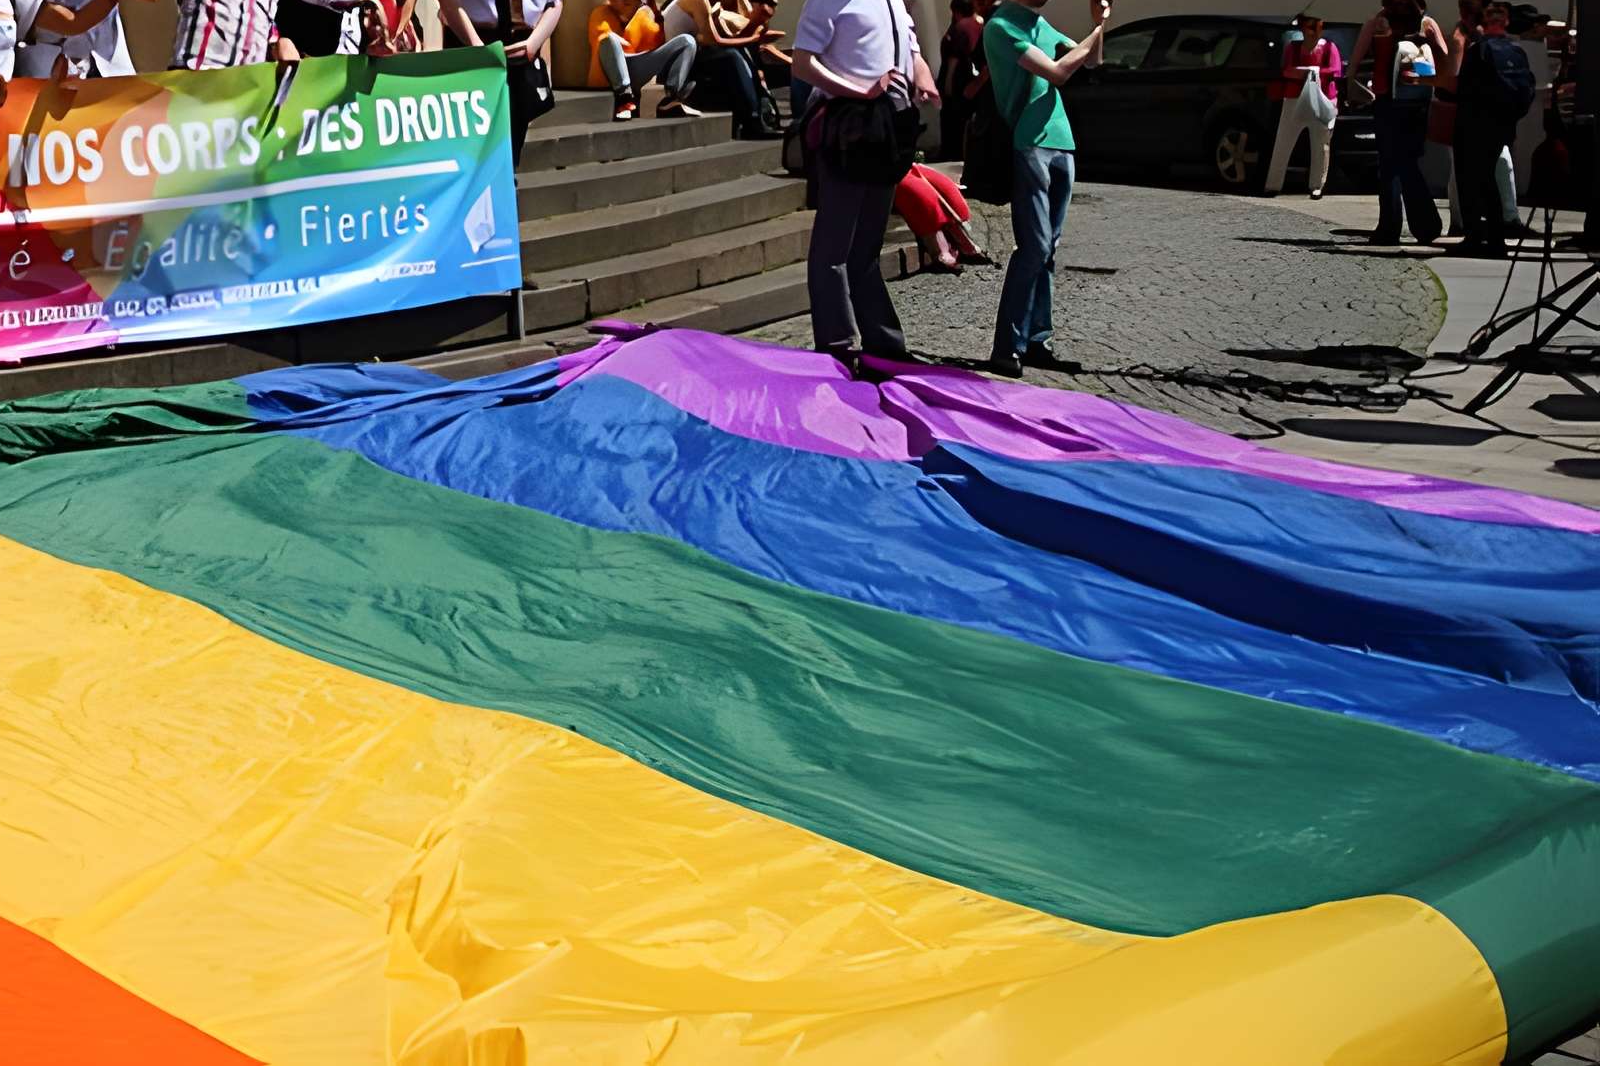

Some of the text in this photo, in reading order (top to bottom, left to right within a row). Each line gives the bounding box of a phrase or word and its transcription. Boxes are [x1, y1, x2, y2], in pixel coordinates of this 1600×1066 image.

[8, 128, 104, 187] NOS
[120, 116, 261, 177] CORPS
[296, 102, 364, 156] DES
[375, 89, 491, 147] DROITS
[300, 195, 430, 247] Fiertés
